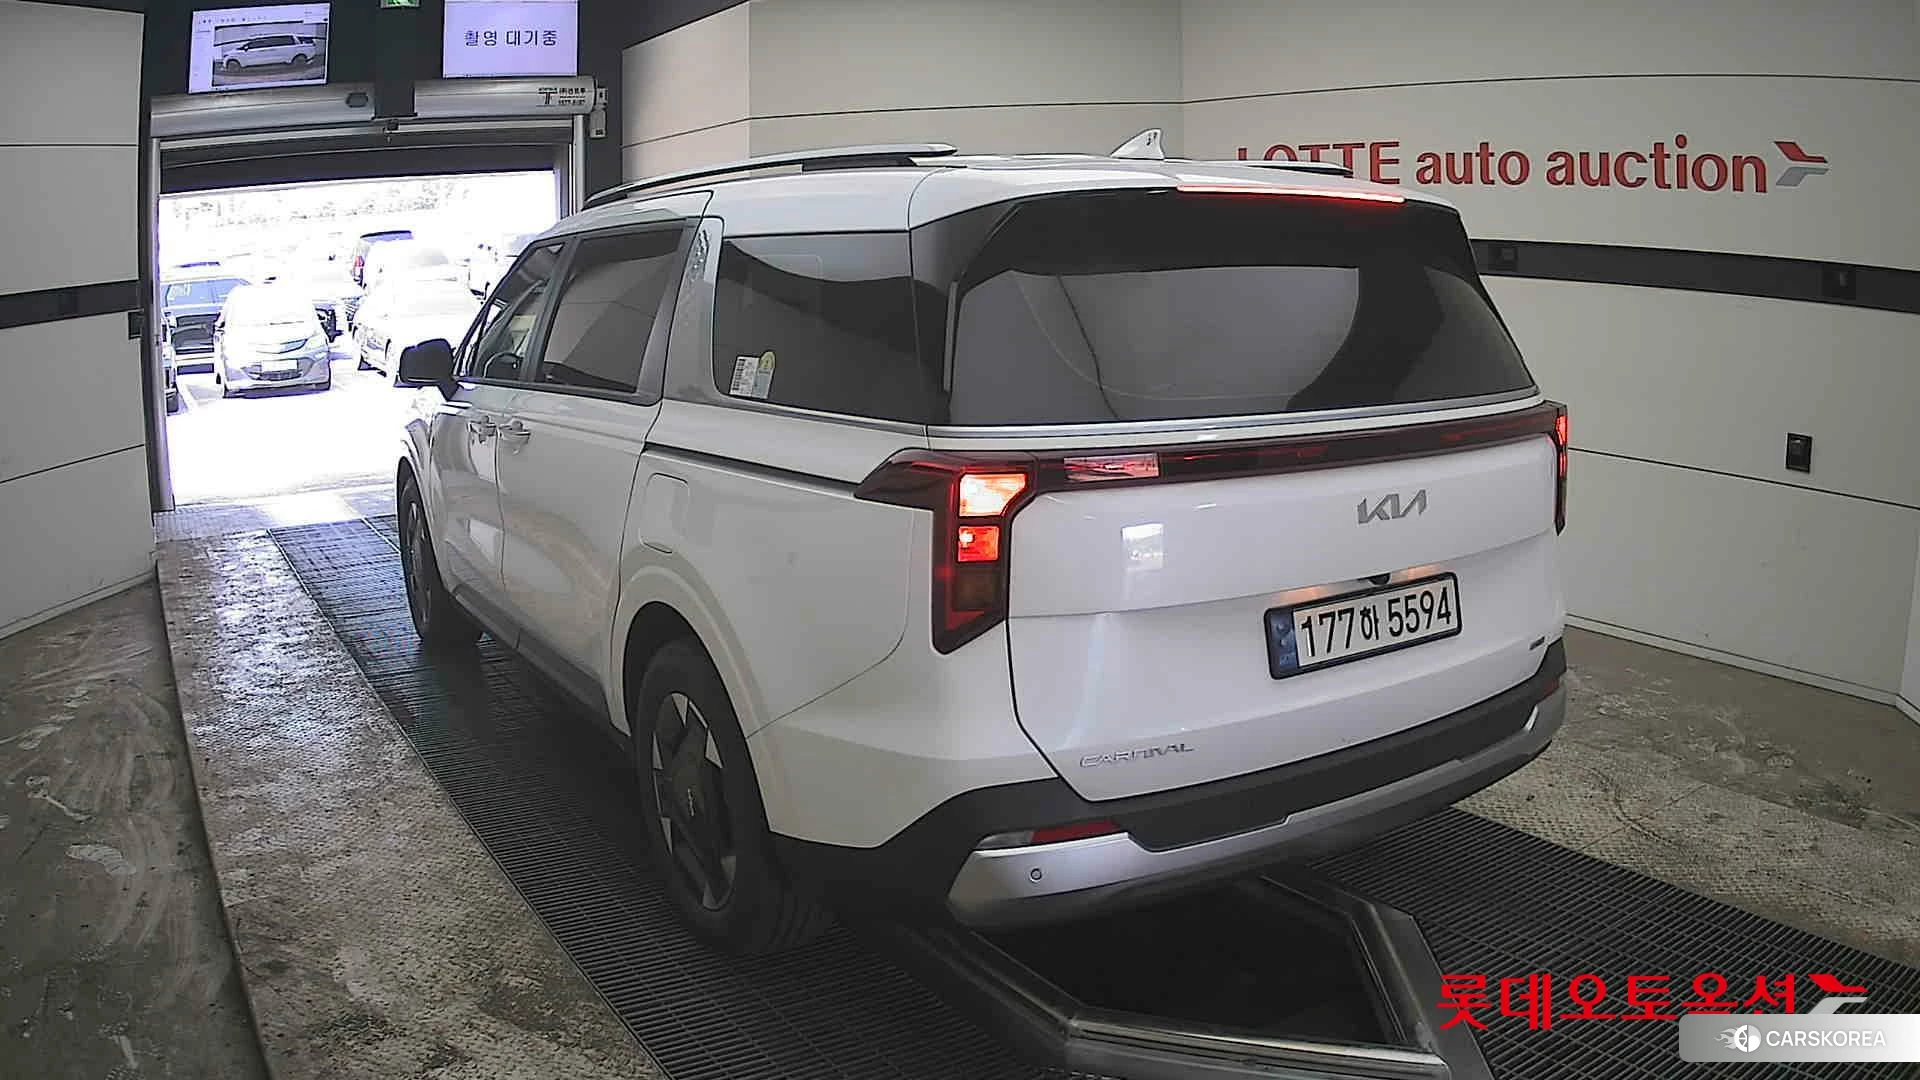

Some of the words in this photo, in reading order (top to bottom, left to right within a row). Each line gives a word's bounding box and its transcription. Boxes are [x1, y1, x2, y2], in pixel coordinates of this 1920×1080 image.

[506, 29, 558, 47] 대기중
[1415, 142, 1530, 186] auto
[1545, 134, 1768, 194] auction
[1357, 489, 1427, 524] KIA
[1388, 586, 1452, 638] 5594
